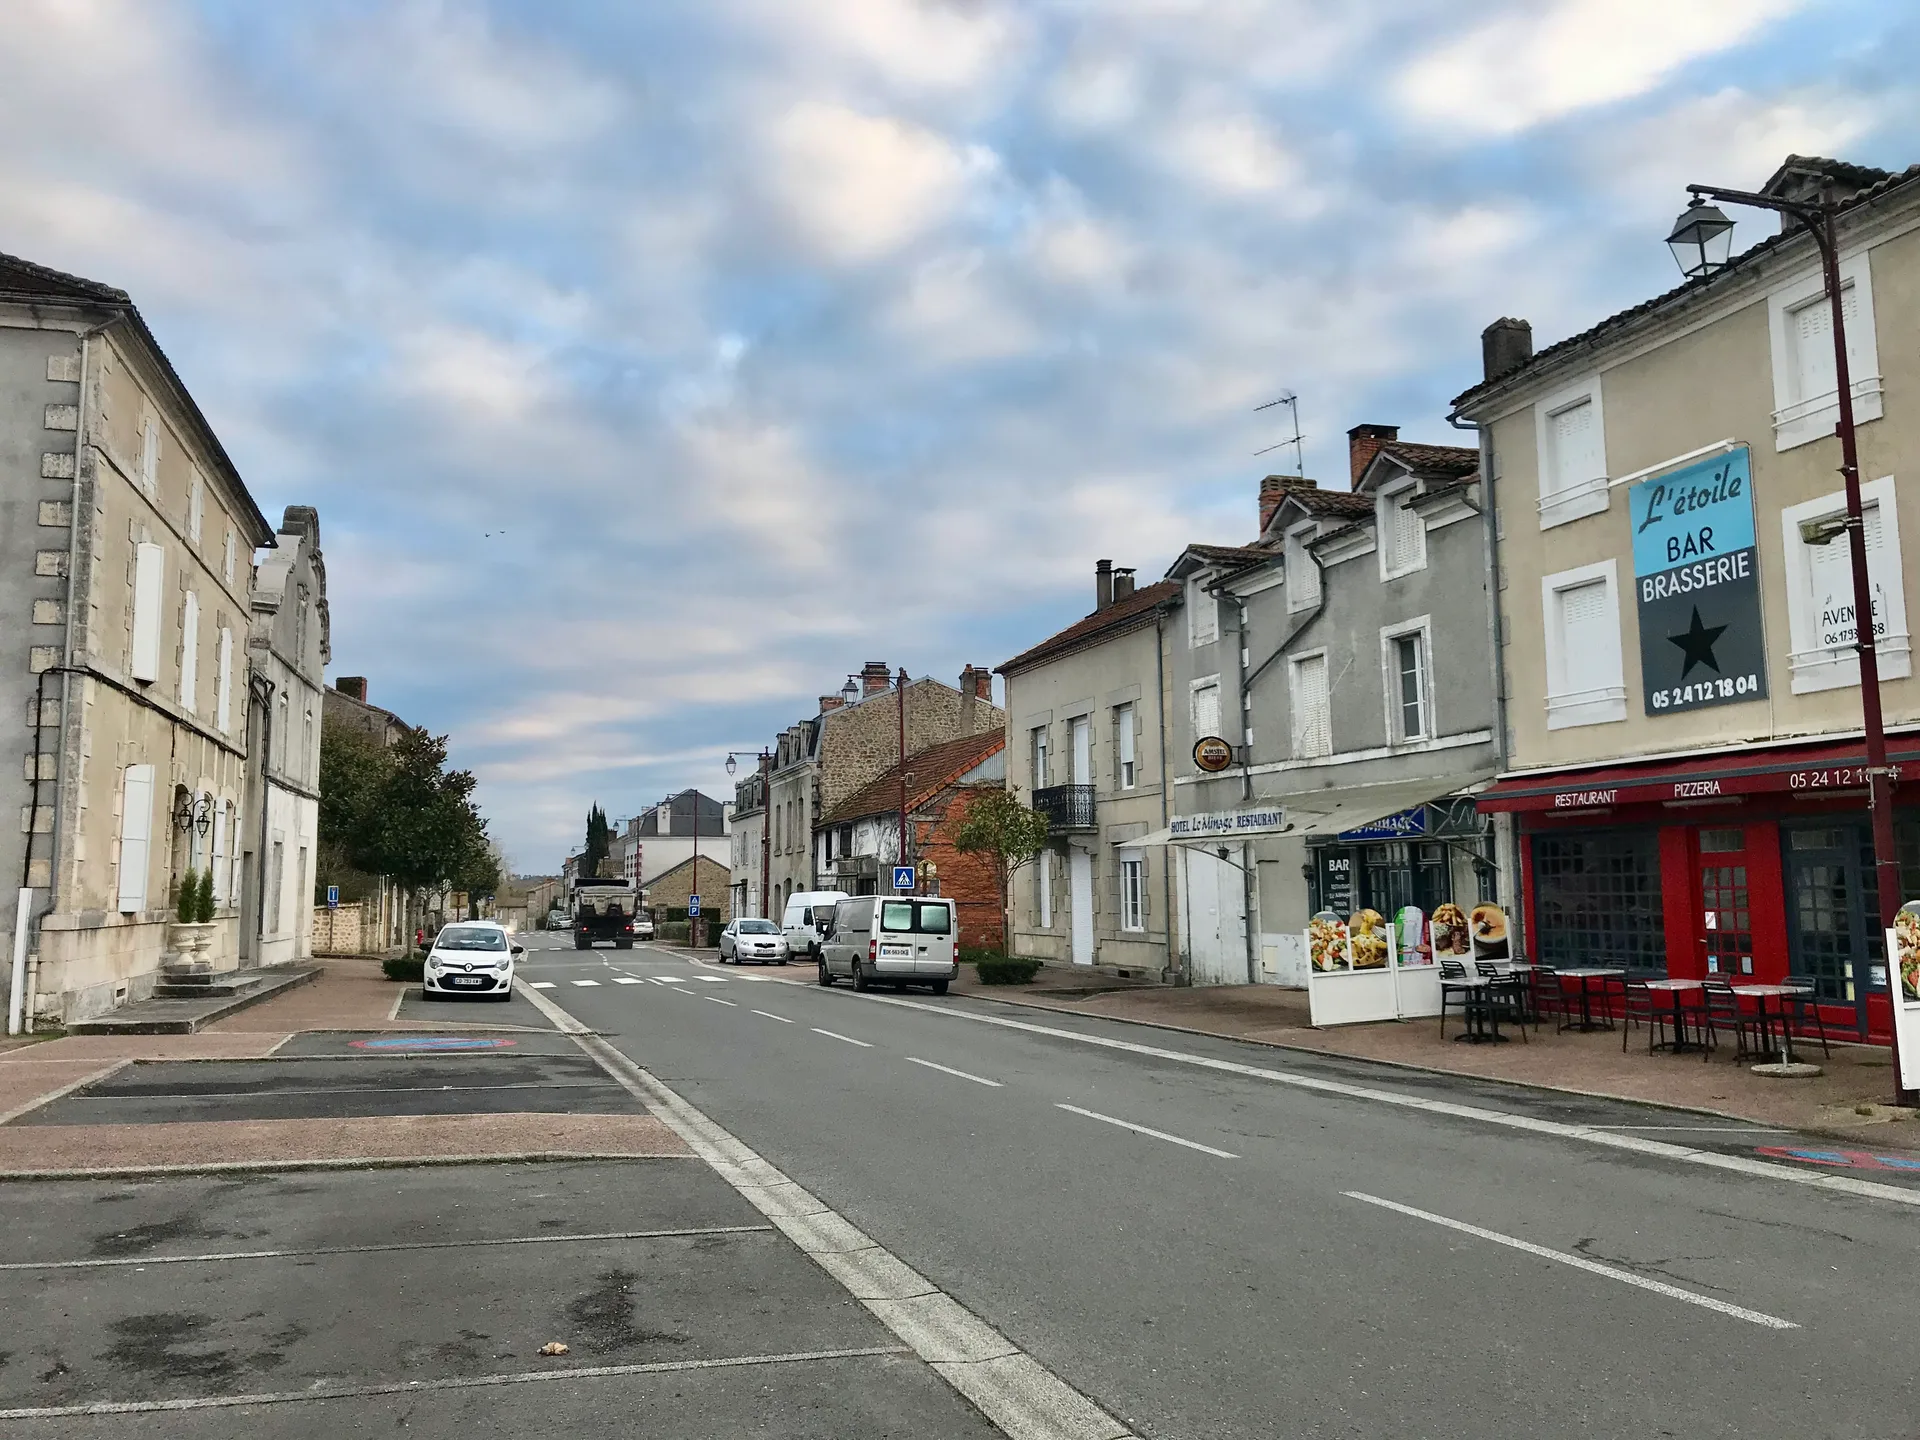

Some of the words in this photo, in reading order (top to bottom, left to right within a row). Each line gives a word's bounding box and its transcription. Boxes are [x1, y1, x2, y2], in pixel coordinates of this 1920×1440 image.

[1638, 462, 1742, 534] L'étoile
[1666, 526, 1716, 563] BAR
[1642, 551, 1751, 603] BRASSERIE
[1652, 689, 1669, 709] 05
[1735, 674, 1758, 694] 04
[1674, 780, 1721, 797] PIZZERIA
[1790, 773, 1806, 788] 05
[1811, 771, 1828, 787] 24
[1834, 769, 1851, 785] 12
[1555, 789, 1618, 807] RESTAURANT
[1171, 820, 1190, 833] HOTEL
[1236, 811, 1283, 828] RESTAURANT
[1328, 858, 1350, 871] BAR
